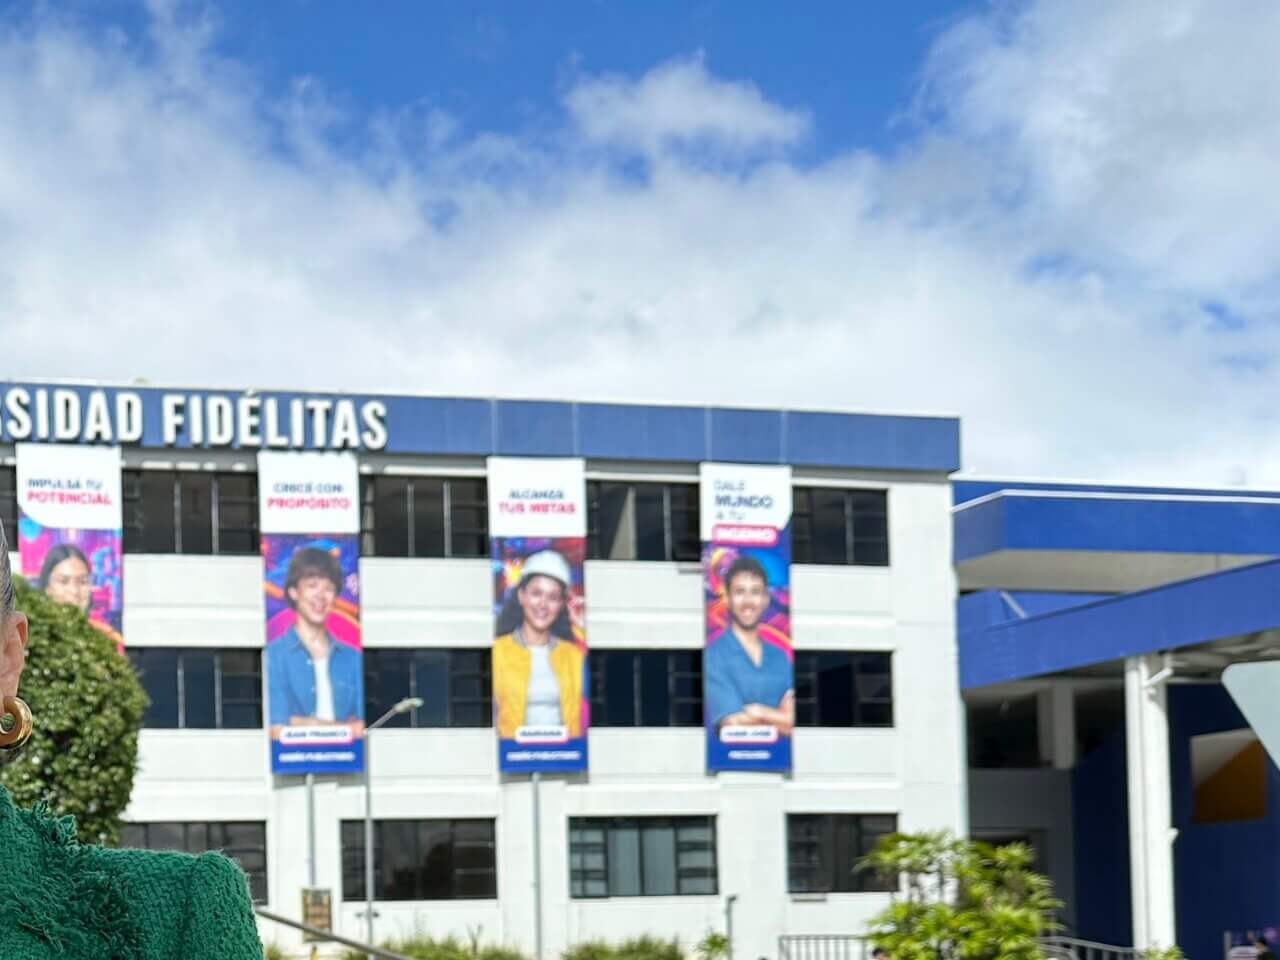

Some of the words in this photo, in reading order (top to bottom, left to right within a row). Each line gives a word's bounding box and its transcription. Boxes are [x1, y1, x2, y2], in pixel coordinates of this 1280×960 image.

[162, 388, 387, 450] FIDÉLITAS
[26, 490, 113, 506] POTENCIAL
[714, 493, 774, 509] MUNDO
